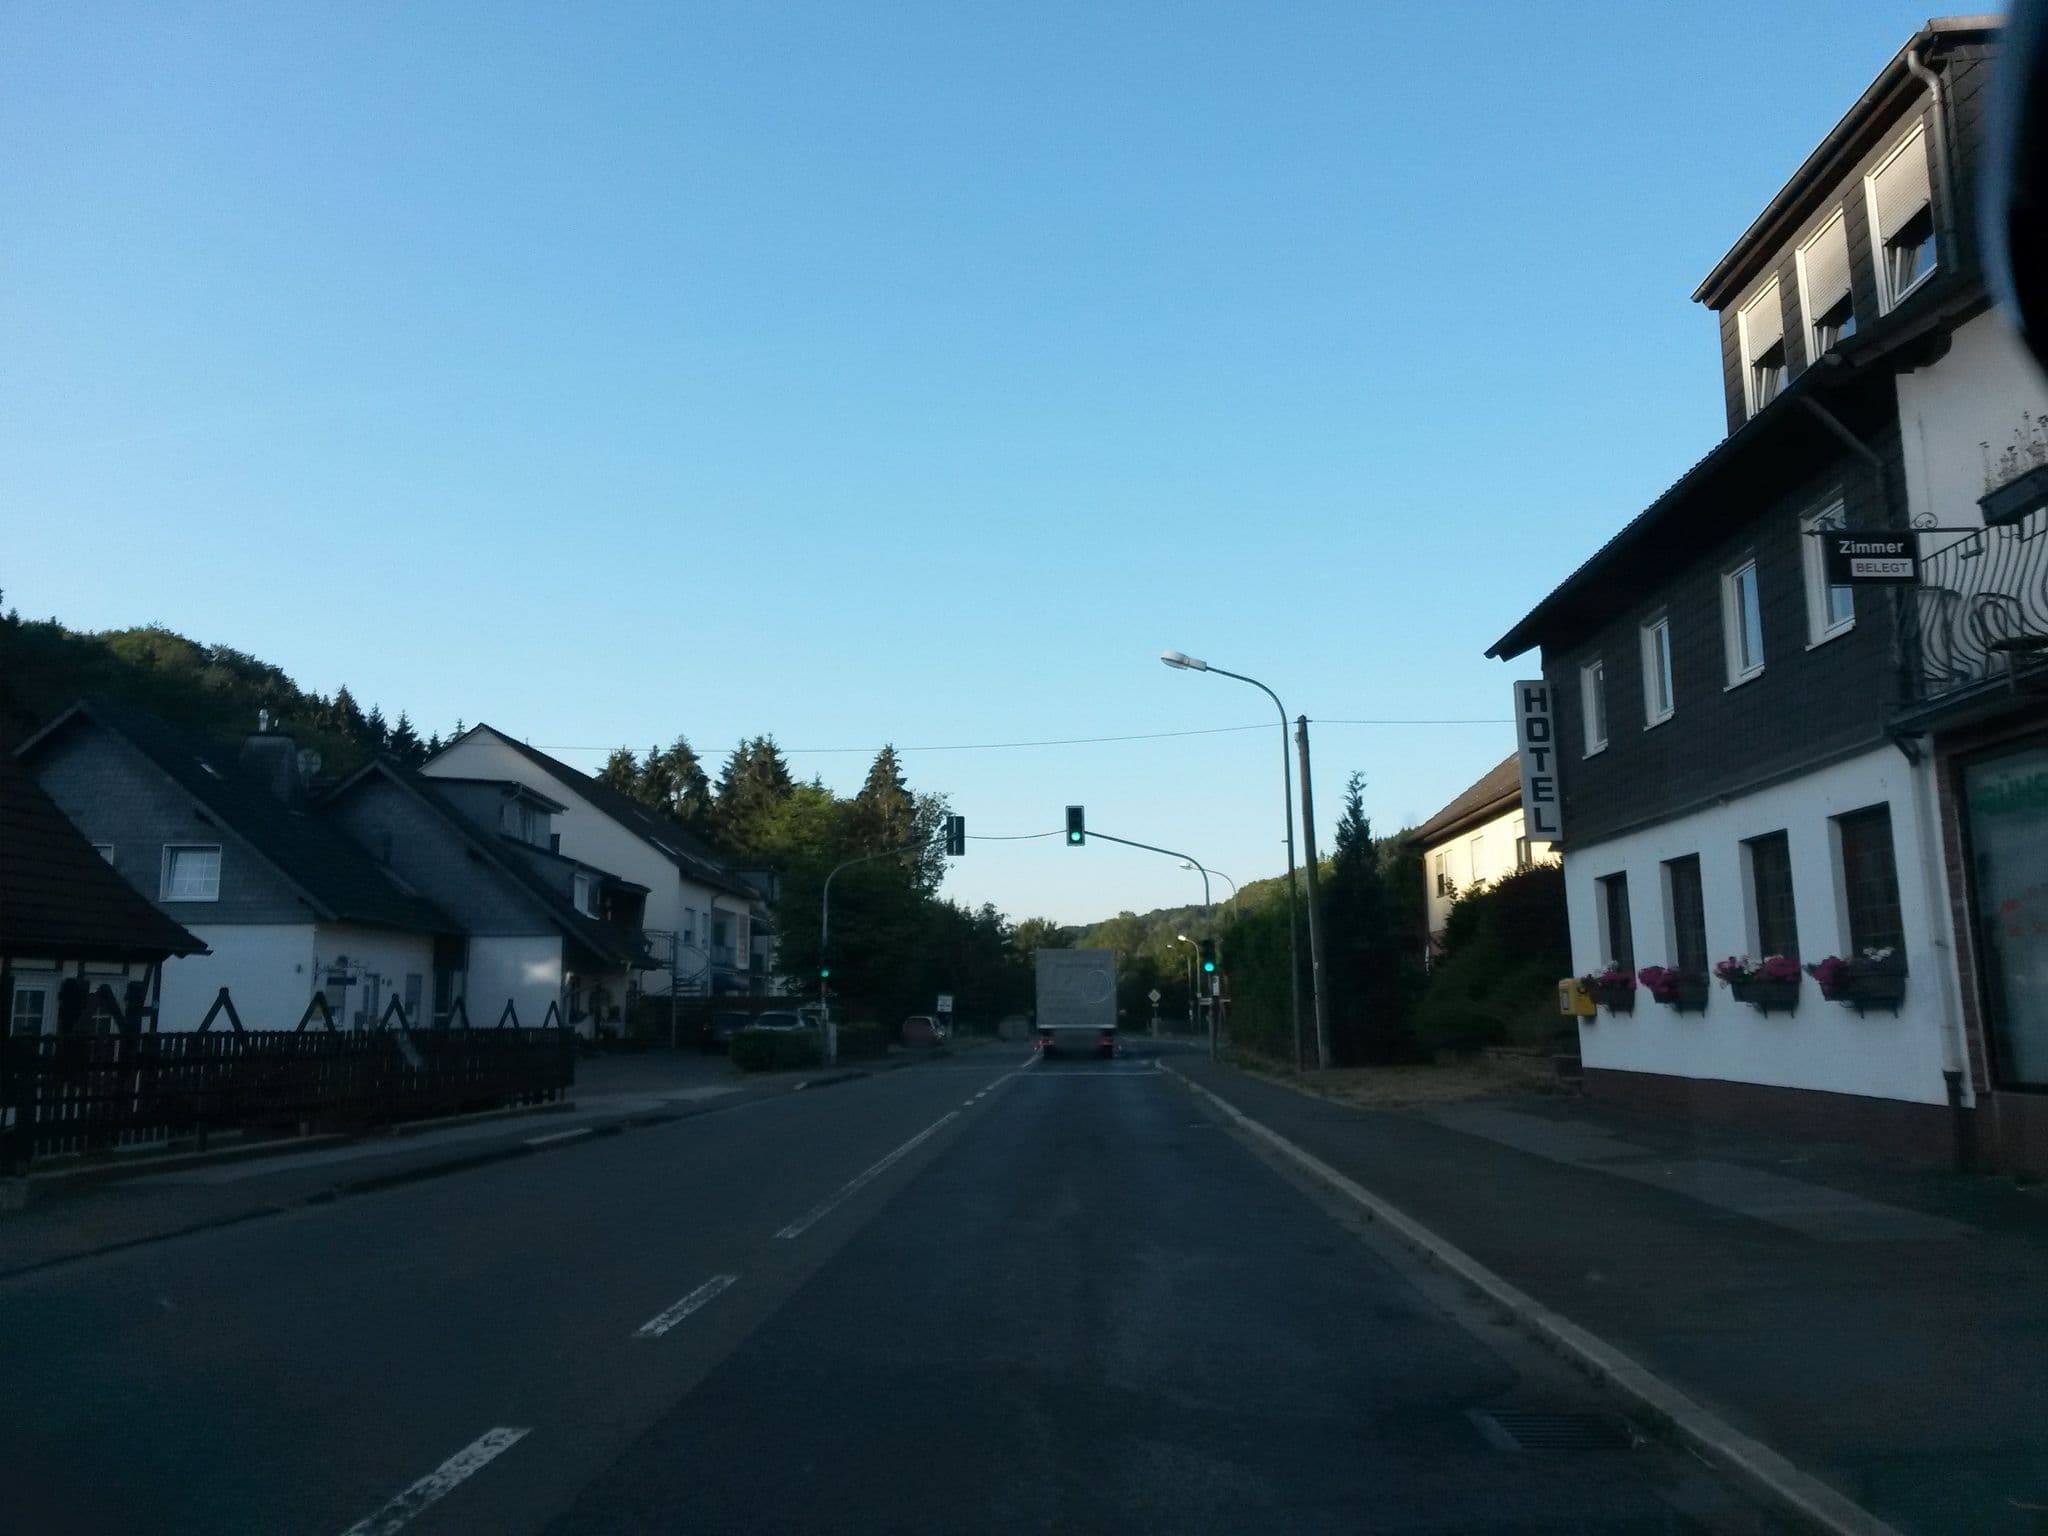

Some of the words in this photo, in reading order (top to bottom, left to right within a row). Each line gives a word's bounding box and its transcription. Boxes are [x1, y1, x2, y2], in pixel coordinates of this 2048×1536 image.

[1838, 540, 1904, 554] Zimmer
[1856, 562, 1908, 573] BELEGT
[1523, 687, 1557, 833] HOTEL
